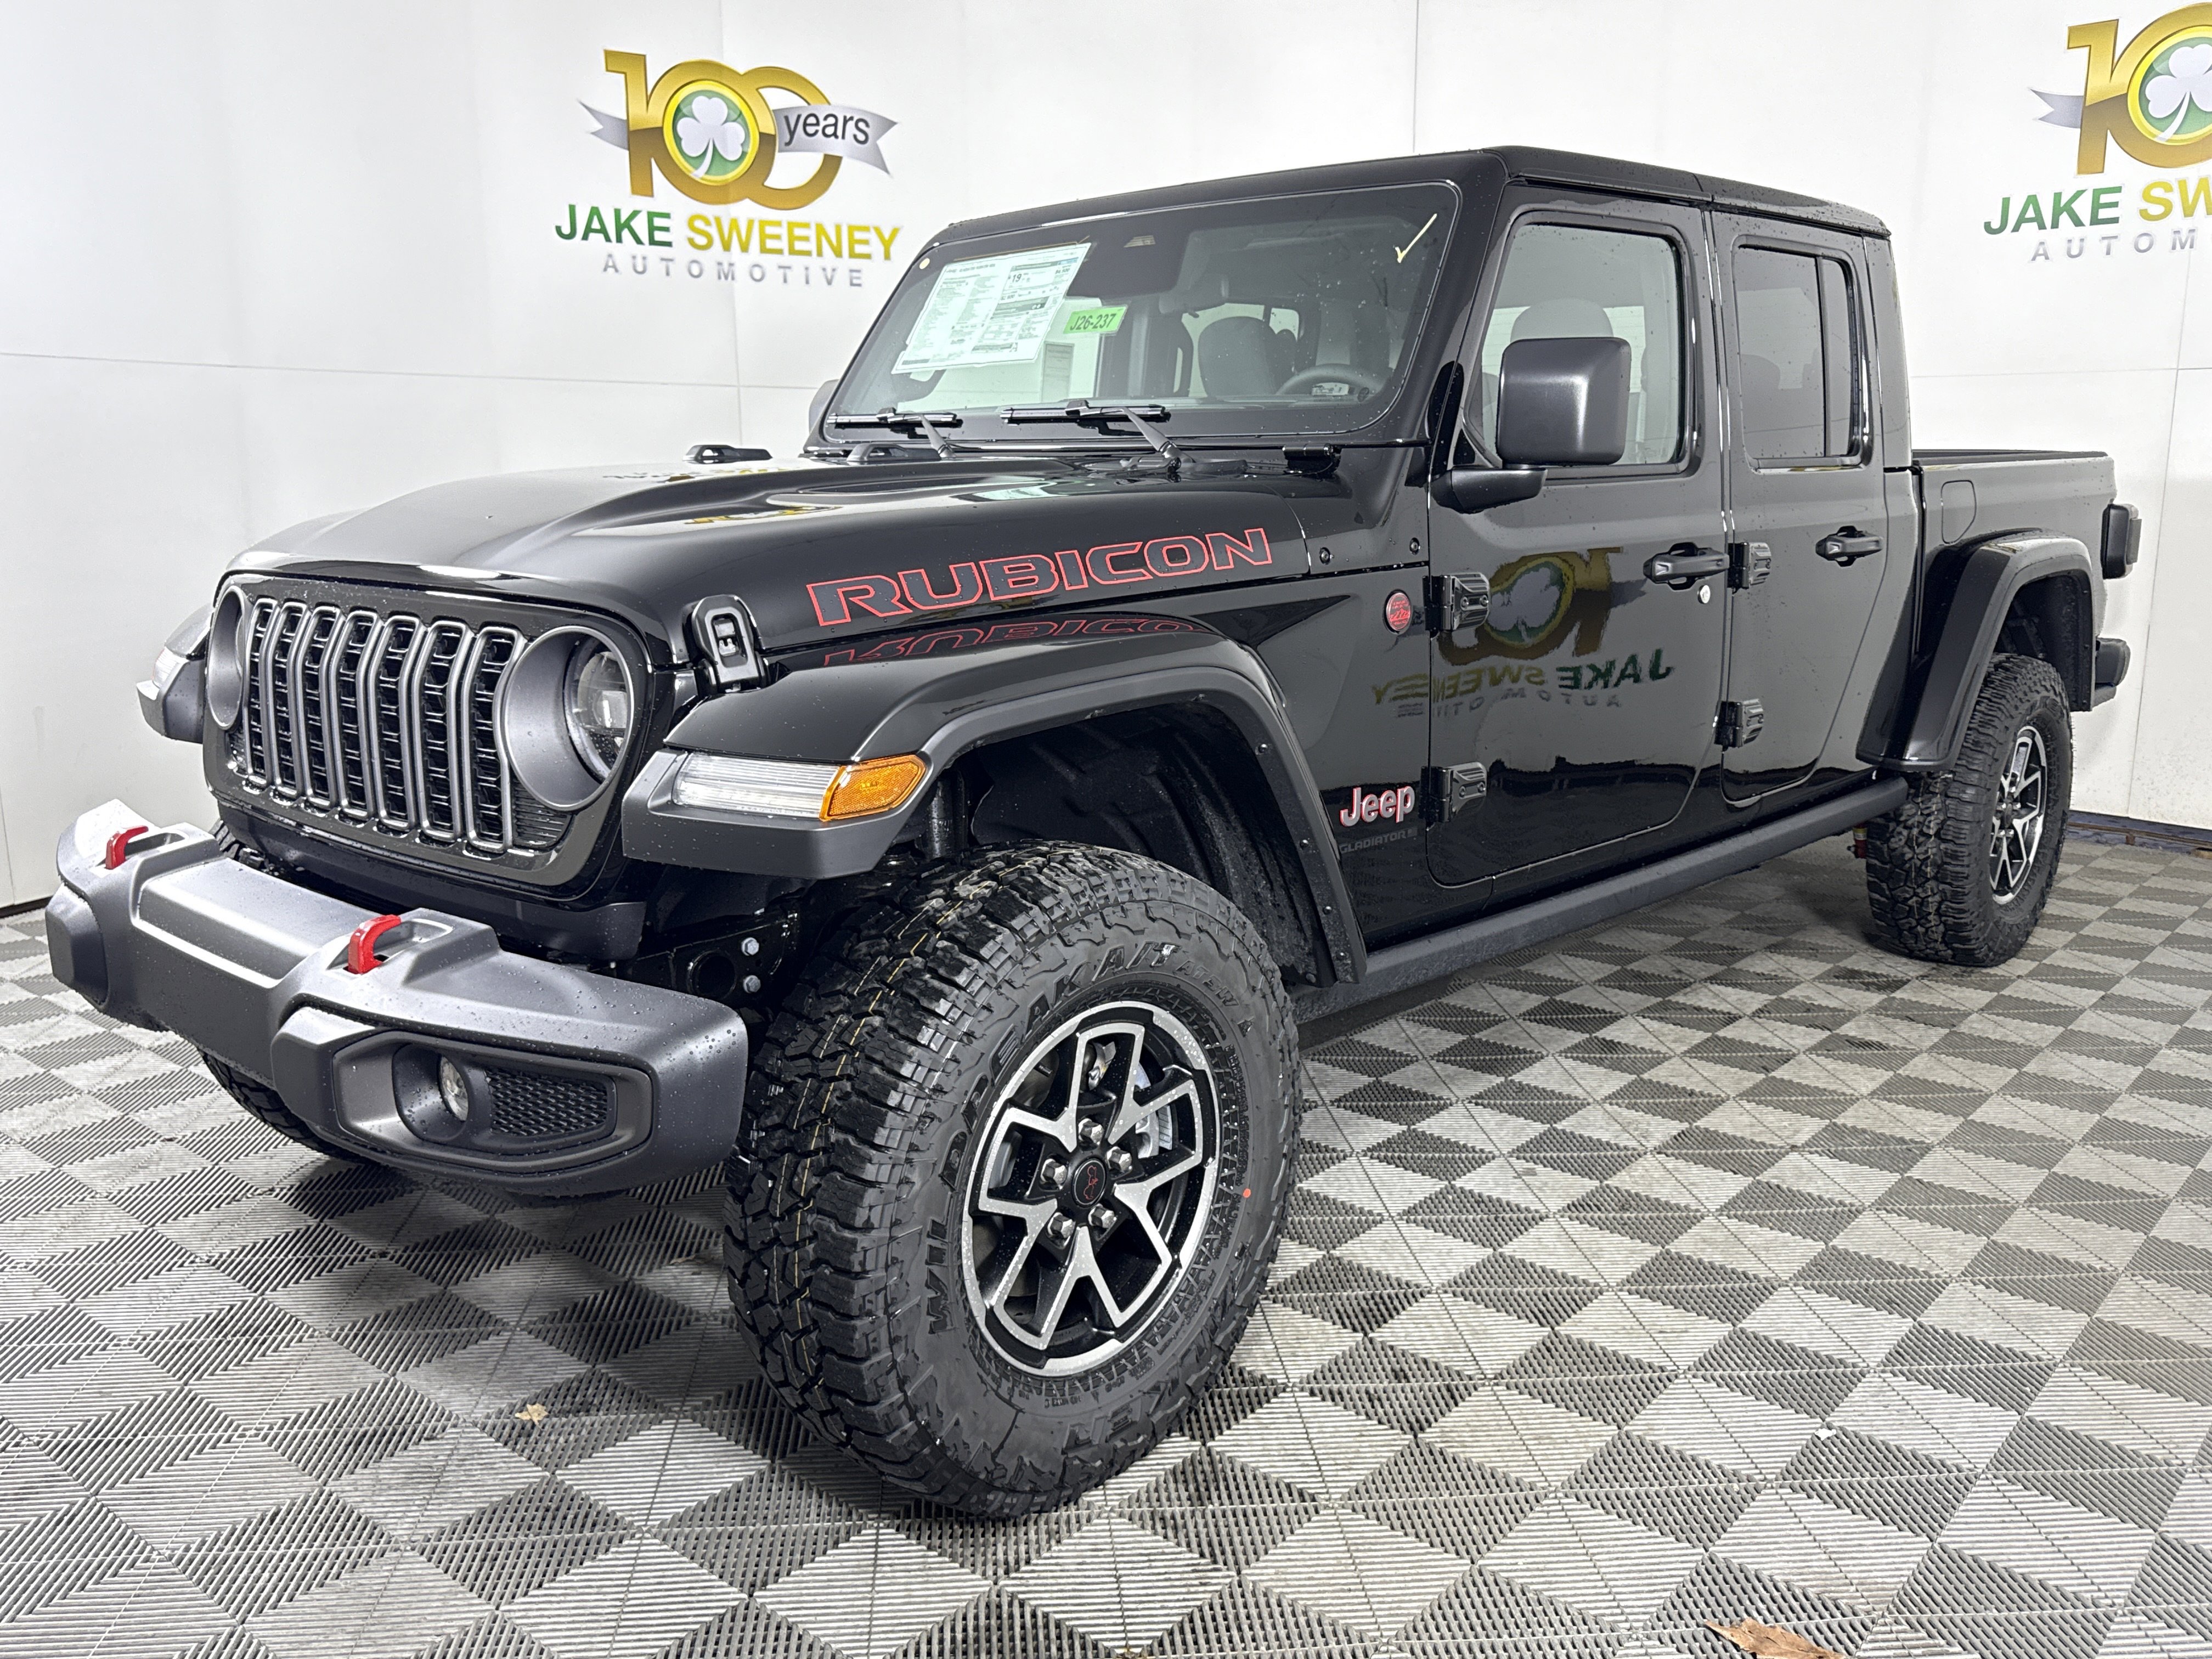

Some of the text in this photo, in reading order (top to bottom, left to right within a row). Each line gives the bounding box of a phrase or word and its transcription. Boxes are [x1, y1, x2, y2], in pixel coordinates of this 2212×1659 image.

[783, 111, 871, 146] years
[1984, 186, 2123, 235] JAKE
[555, 204, 900, 261] JAKE SWEENEY
[603, 253, 863, 287] AUTOMOTIVE
[1070, 313, 1116, 330] J26-237
[806, 528, 1273, 626] RUBICON
[1340, 786, 1415, 827] Jeep
[1339, 830, 1406, 854] GLADIATOR
